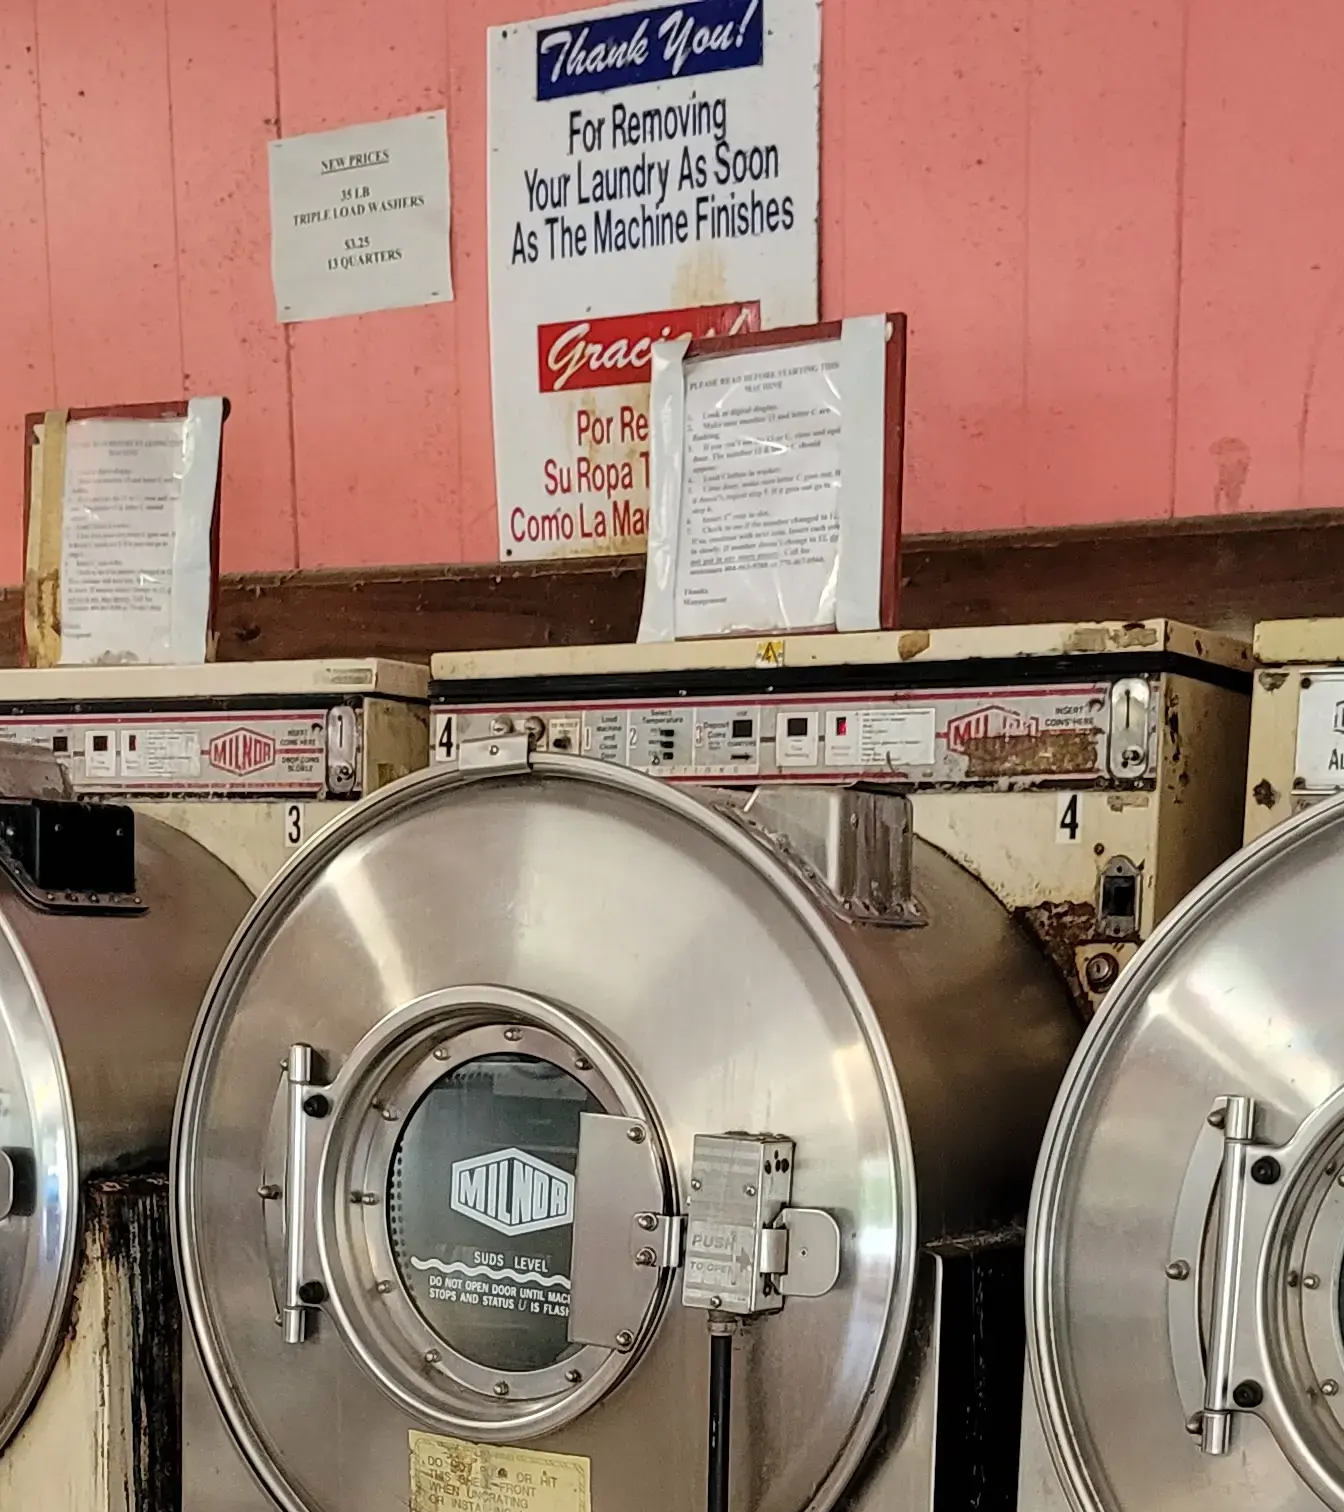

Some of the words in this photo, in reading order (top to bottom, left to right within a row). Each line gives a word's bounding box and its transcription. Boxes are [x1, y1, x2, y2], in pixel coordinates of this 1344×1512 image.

[540, 19, 650, 82] Thank
[658, 0, 756, 76] You!
[569, 110, 605, 154] For
[612, 98, 726, 149] Removing
[321, 157, 344, 172] NEW
[349, 150, 389, 166] PRICES
[524, 169, 571, 212] Your
[577, 153, 670, 205] Laundry
[678, 147, 707, 191] As
[714, 143, 778, 184] Soon
[293, 207, 331, 226] TRIPLE
[333, 204, 365, 219] LOAD
[368, 196, 425, 212] WASHERS
[340, 189, 352, 201] 35
[355, 186, 370, 199] LB
[511, 222, 538, 265] As
[545, 217, 587, 260] The
[594, 204, 688, 254] Machine
[696, 189, 794, 241] Finishes
[340, 250, 402, 269] QUARTERS
[577, 409, 613, 446] Por
[545, 459, 571, 495] Su
[577, 456, 633, 498] Ropa
[511, 507, 573, 543] Como
[579, 503, 606, 538] La
[612, 500, 649, 536] Ma
[213, 730, 271, 769] MILNOR
[439, 716, 454, 758] 4
[288, 804, 302, 844] 3
[1059, 794, 1079, 840] 4
[458, 1158, 569, 1225] MILNOR
[474, 1251, 504, 1267] SUDS
[514, 1256, 548, 1273] LEVEL
[429, 1275, 442, 1286] DO
[445, 1277, 462, 1289] NOT
[465, 1280, 489, 1293] OPEN
[491, 1284, 517, 1297] DOOR
[520, 1288, 545, 1301] UNTIL
[548, 1291, 570, 1303] MAC
[429, 1288, 456, 1300] STOPS
[460, 1292, 479, 1304] AND
[482, 1296, 514, 1309] STATUS
[531, 1302, 540, 1313] IS
